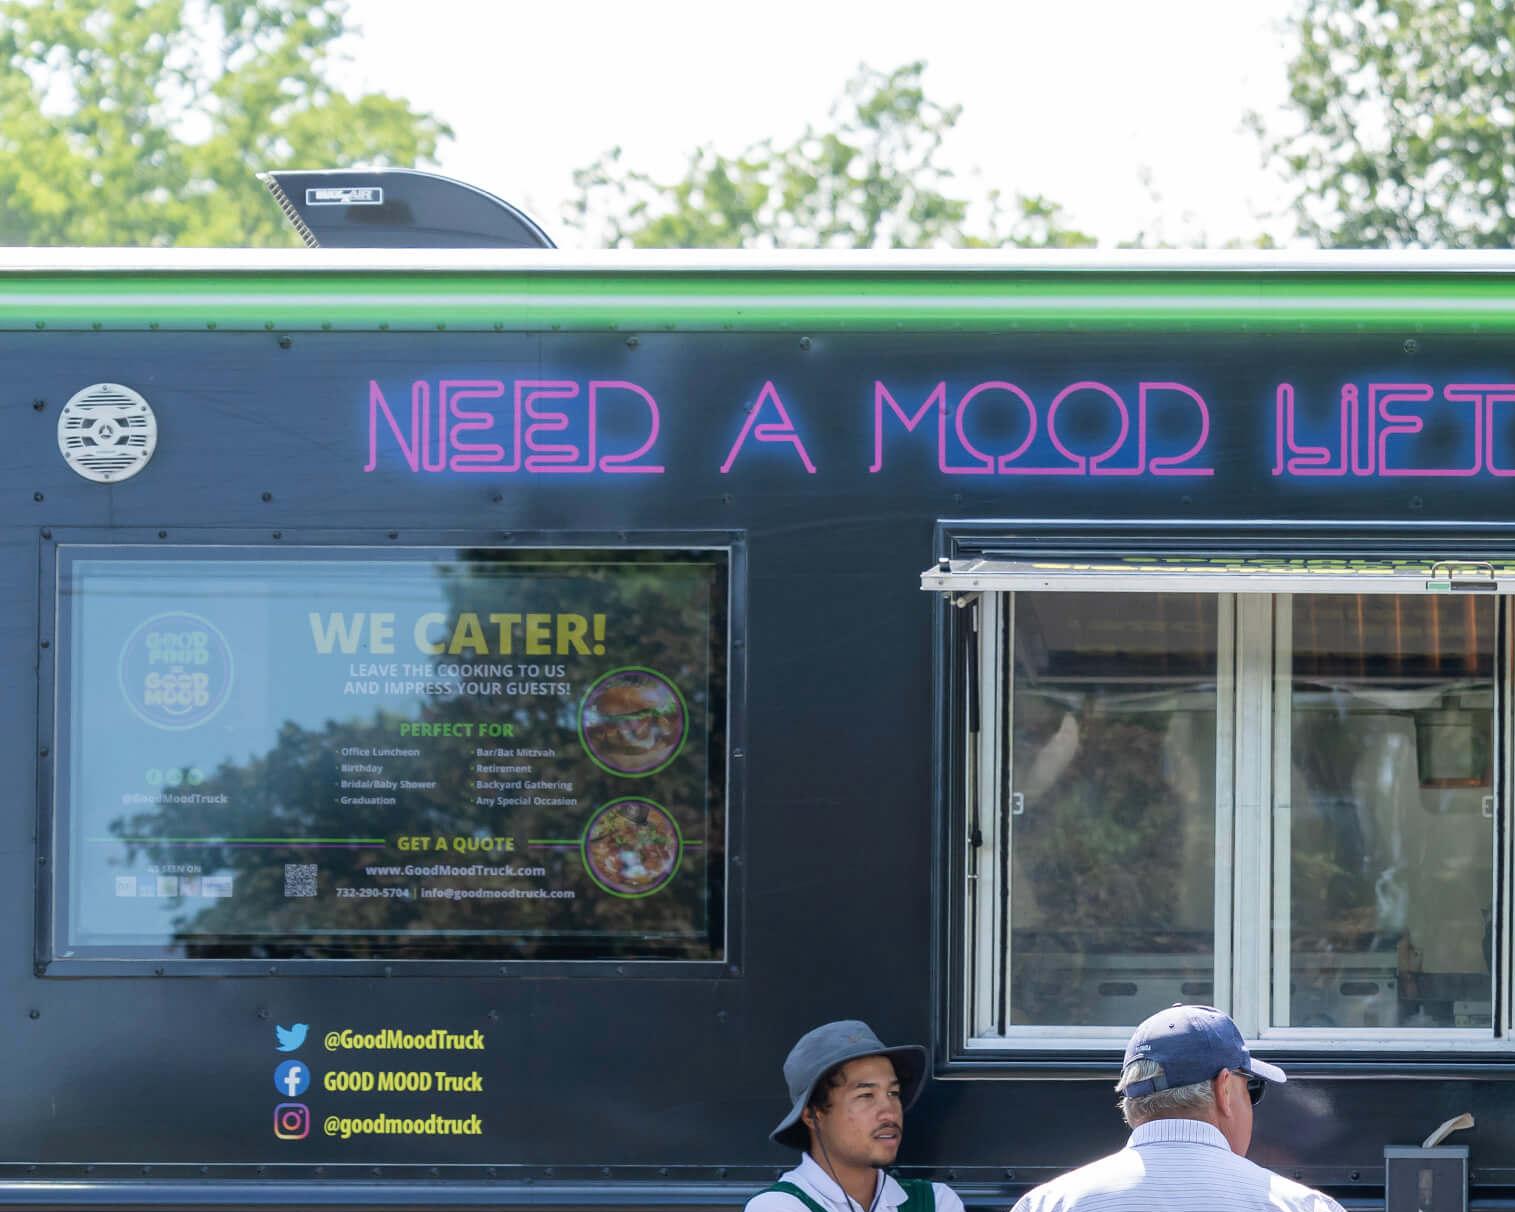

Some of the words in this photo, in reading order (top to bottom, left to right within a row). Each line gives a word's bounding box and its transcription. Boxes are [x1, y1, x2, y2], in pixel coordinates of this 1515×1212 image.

[364, 379, 664, 473] NEED
[720, 380, 816, 474] A
[869, 380, 1214, 476] MOOD
[308, 613, 395, 655] WE
[413, 612, 607, 656] CATER!
[350, 664, 398, 678] LEAVE
[402, 664, 433, 678] THE
[437, 664, 513, 678] COOKING
[517, 664, 540, 678] TO
[544, 664, 565, 678] US
[344, 681, 378, 695] AND
[384, 681, 452, 695] IMPRESS
[456, 681, 502, 695] YOUR
[506, 681, 571, 695] GUESTS!
[400, 723, 473, 738] PERFECT
[479, 723, 514, 738] FOR
[341, 747, 370, 758] Office
[372, 747, 420, 758] Luncheon
[476, 747, 514, 758] Bar/Bat
[517, 747, 555, 758] Mitzvah
[340, 763, 383, 775] Birthday
[476, 763, 532, 774] Retirement
[340, 779, 397, 791] Bridal/Baby
[400, 780, 436, 789] Shower
[476, 779, 522, 791] Backyard
[524, 779, 573, 792] Gathering
[340, 795, 396, 806] Graduation
[476, 795, 495, 808] Any
[497, 795, 531, 808] Special
[534, 795, 577, 807] Occasion
[397, 836, 434, 851] GET
[435, 836, 448, 851] A
[453, 836, 515, 854] QUOTE
[366, 864, 546, 877] www.GoodMoodTruck.com
[336, 887, 409, 899] 732-290-5704
[421, 887, 575, 900] info@goodmoodtruck.com
[324, 1029, 484, 1051] @GoodMoodTruck
[324, 1072, 374, 1091] GOOD
[377, 1072, 432, 1091] MOOD
[435, 1072, 483, 1092] Truck
[324, 1113, 482, 1139] @goodmoodtruck
